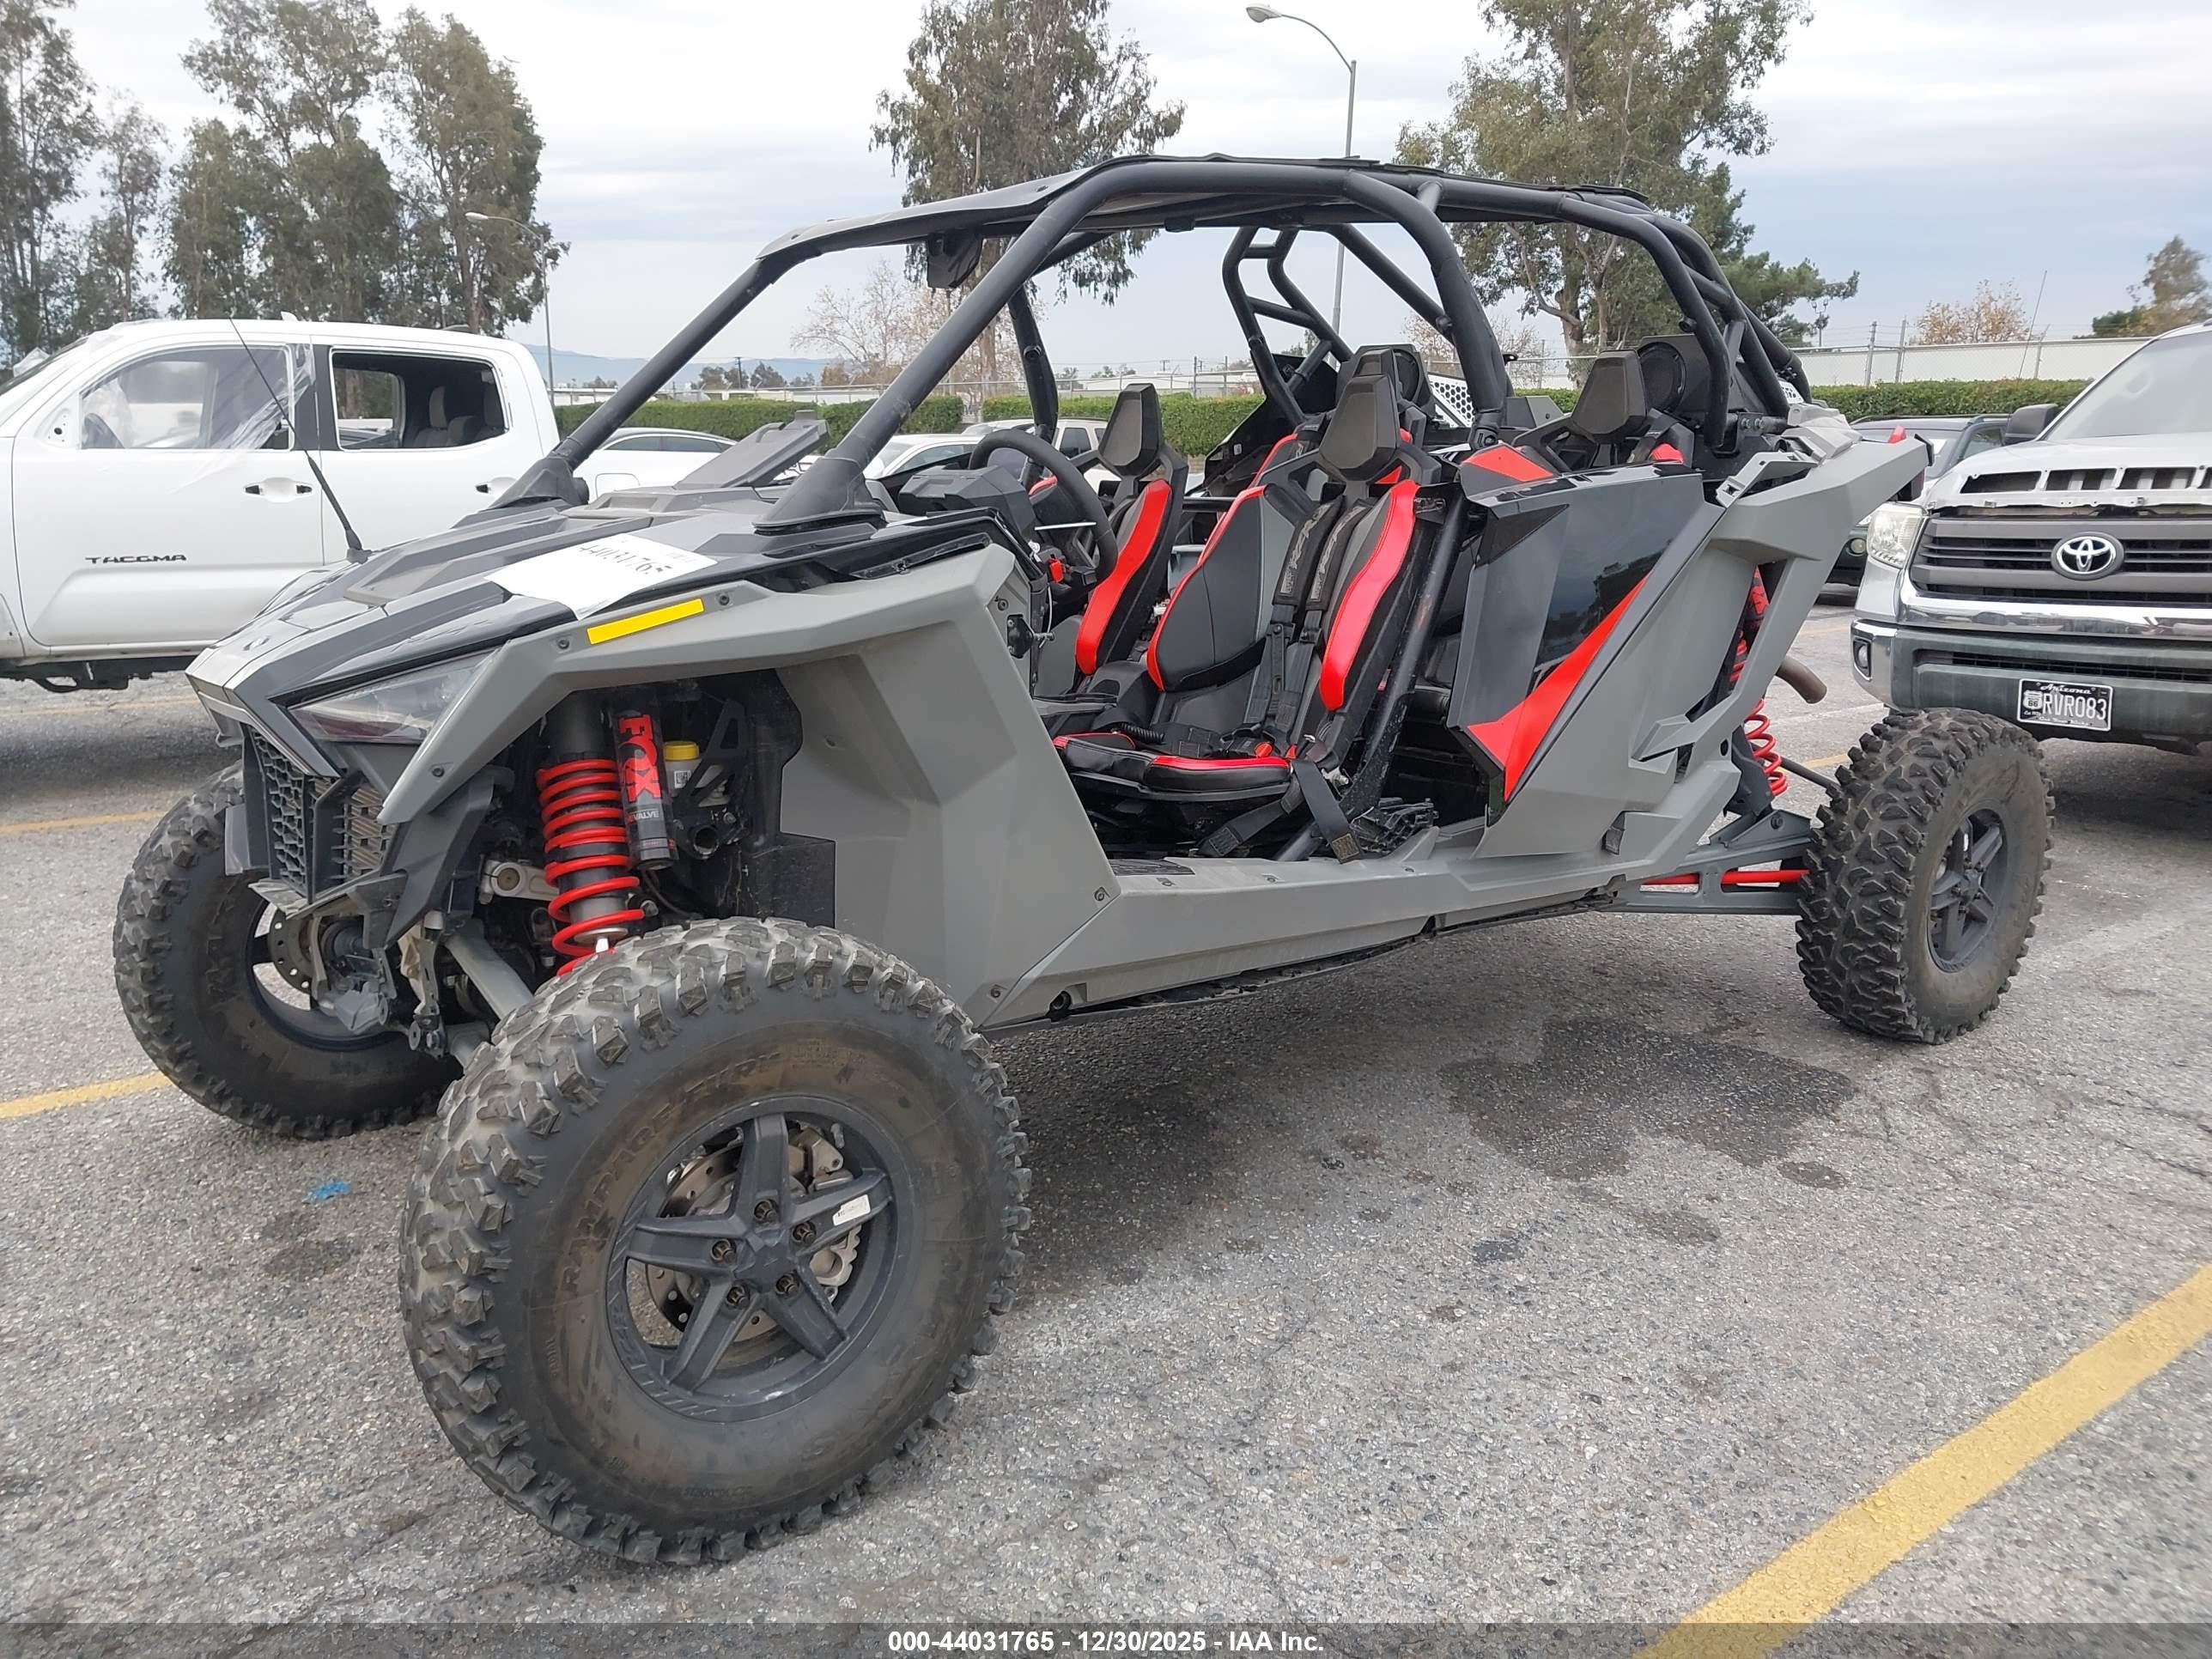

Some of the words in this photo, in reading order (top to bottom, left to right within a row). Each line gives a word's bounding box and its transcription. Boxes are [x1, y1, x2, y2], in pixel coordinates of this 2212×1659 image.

[84, 554, 187, 564] TACOMA
[2040, 684, 2092, 695] Arizona
[2043, 692, 2107, 720] RVR083
[617, 714, 663, 804] FOX
